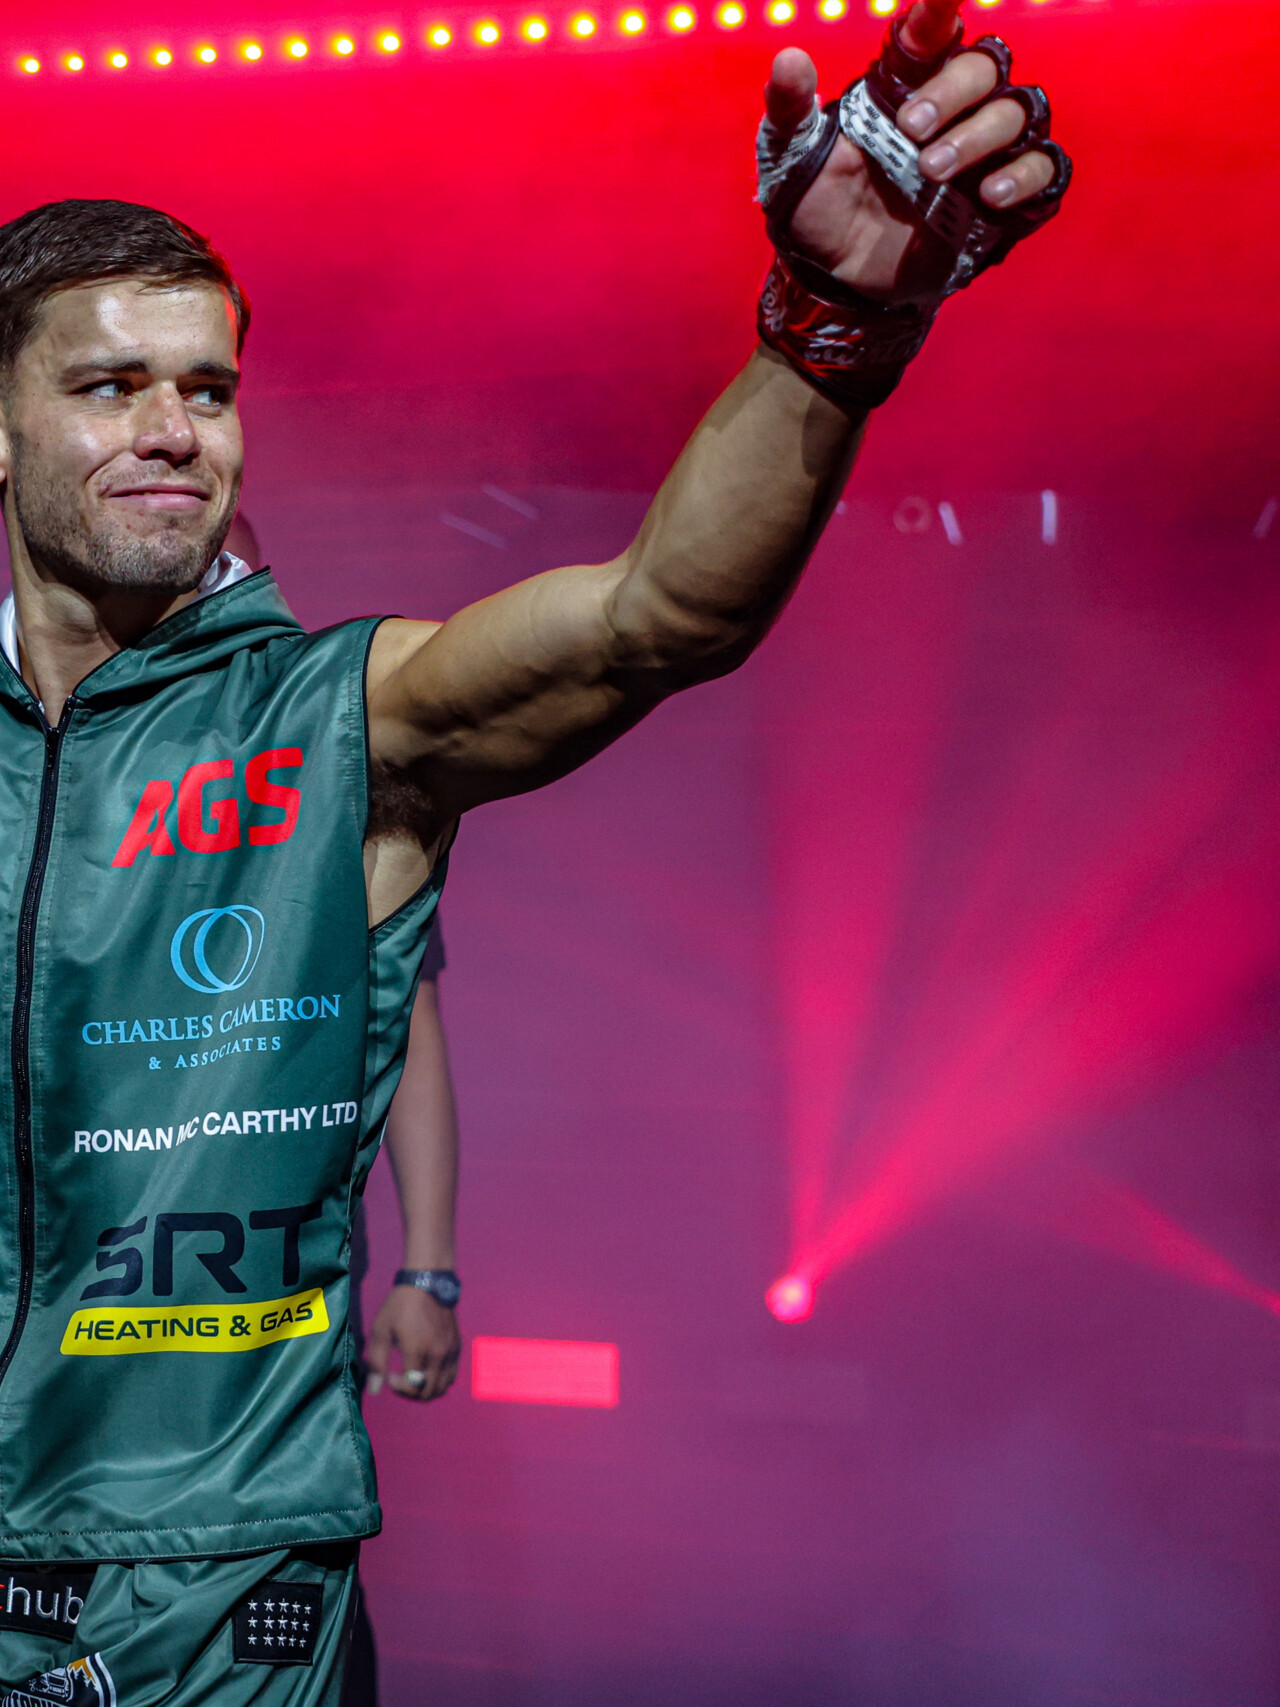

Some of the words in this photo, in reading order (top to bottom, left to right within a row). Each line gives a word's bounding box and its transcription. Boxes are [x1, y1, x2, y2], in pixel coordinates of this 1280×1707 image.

[110, 747, 303, 868] AGS
[81, 1015, 213, 1045] CHARLES
[220, 994, 341, 1034] CAMERON
[148, 1056, 161, 1070] &
[174, 1036, 281, 1069] ASSOCIATES
[74, 1127, 173, 1153] RONAN
[176, 1117, 199, 1146] MC
[202, 1106, 317, 1135] CARTHY
[322, 1101, 358, 1127] LTD
[80, 1203, 322, 1301] SRT
[74, 1317, 219, 1341] HEATING
[229, 1315, 251, 1337] &
[260, 1301, 314, 1332] GAS
